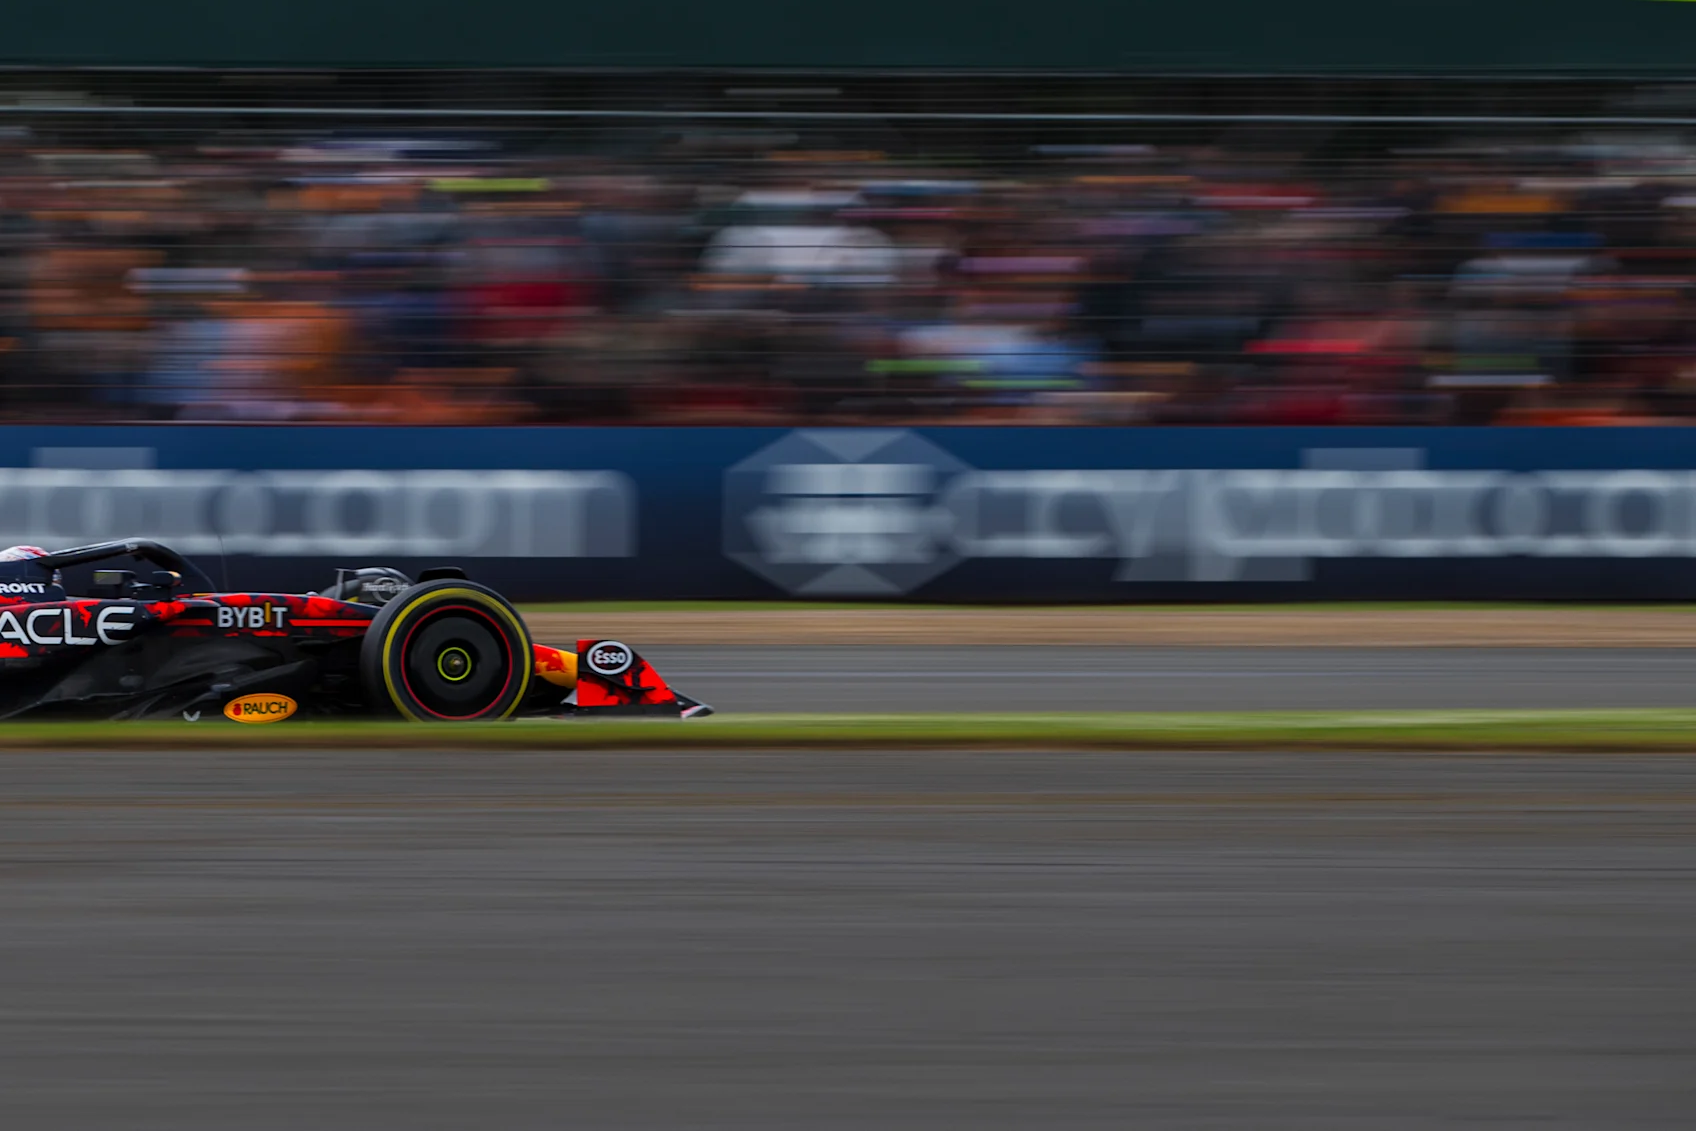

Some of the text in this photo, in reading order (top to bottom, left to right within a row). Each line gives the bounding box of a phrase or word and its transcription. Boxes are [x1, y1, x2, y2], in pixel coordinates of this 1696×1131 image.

[217, 601, 288, 628] BYBIT
[593, 649, 626, 665] Esso
[243, 701, 288, 716] RAUCH
